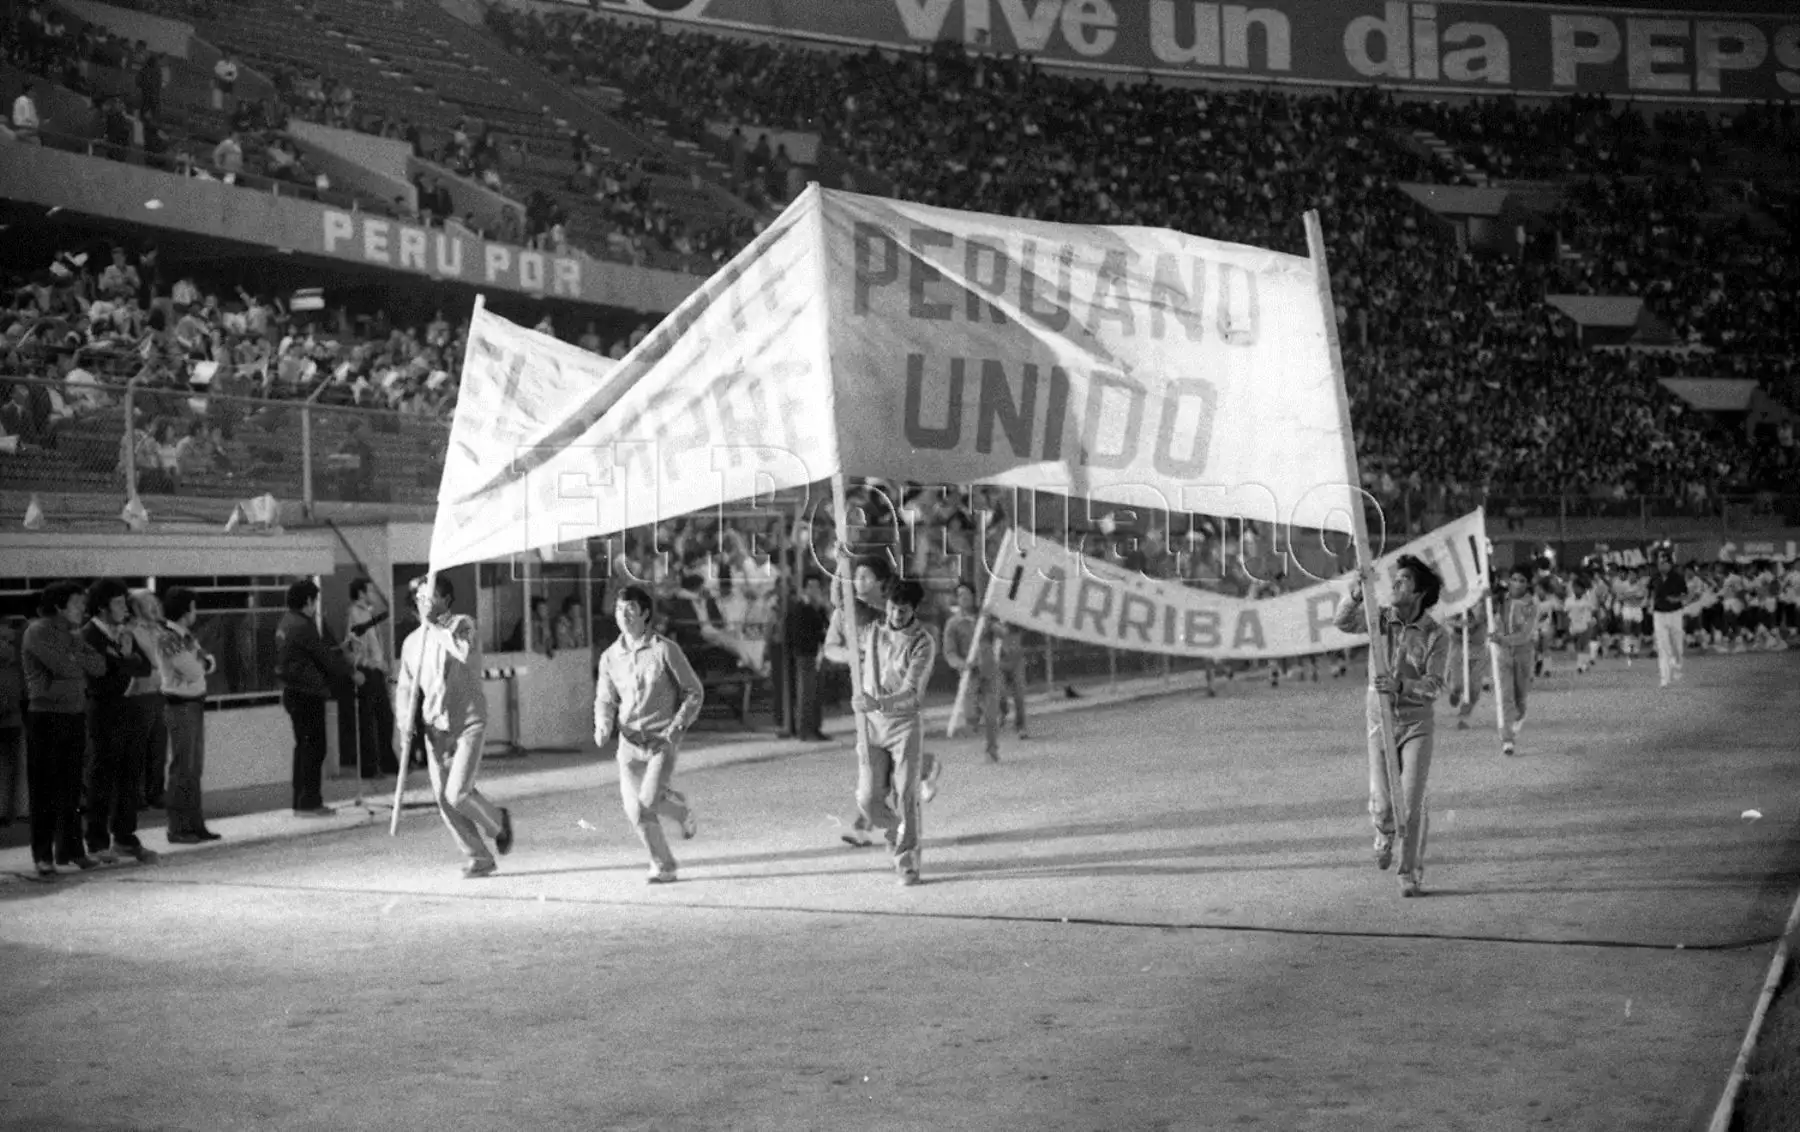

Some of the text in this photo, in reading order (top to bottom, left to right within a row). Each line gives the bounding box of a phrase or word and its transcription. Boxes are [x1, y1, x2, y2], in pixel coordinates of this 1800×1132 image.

[1150, 0, 1291, 70] un
[323, 210, 580, 297] PERU POR
[854, 221, 1261, 346] PERUANO
[904, 353, 1218, 480] UNIDO
[1305, 534, 1483, 643] PU!
